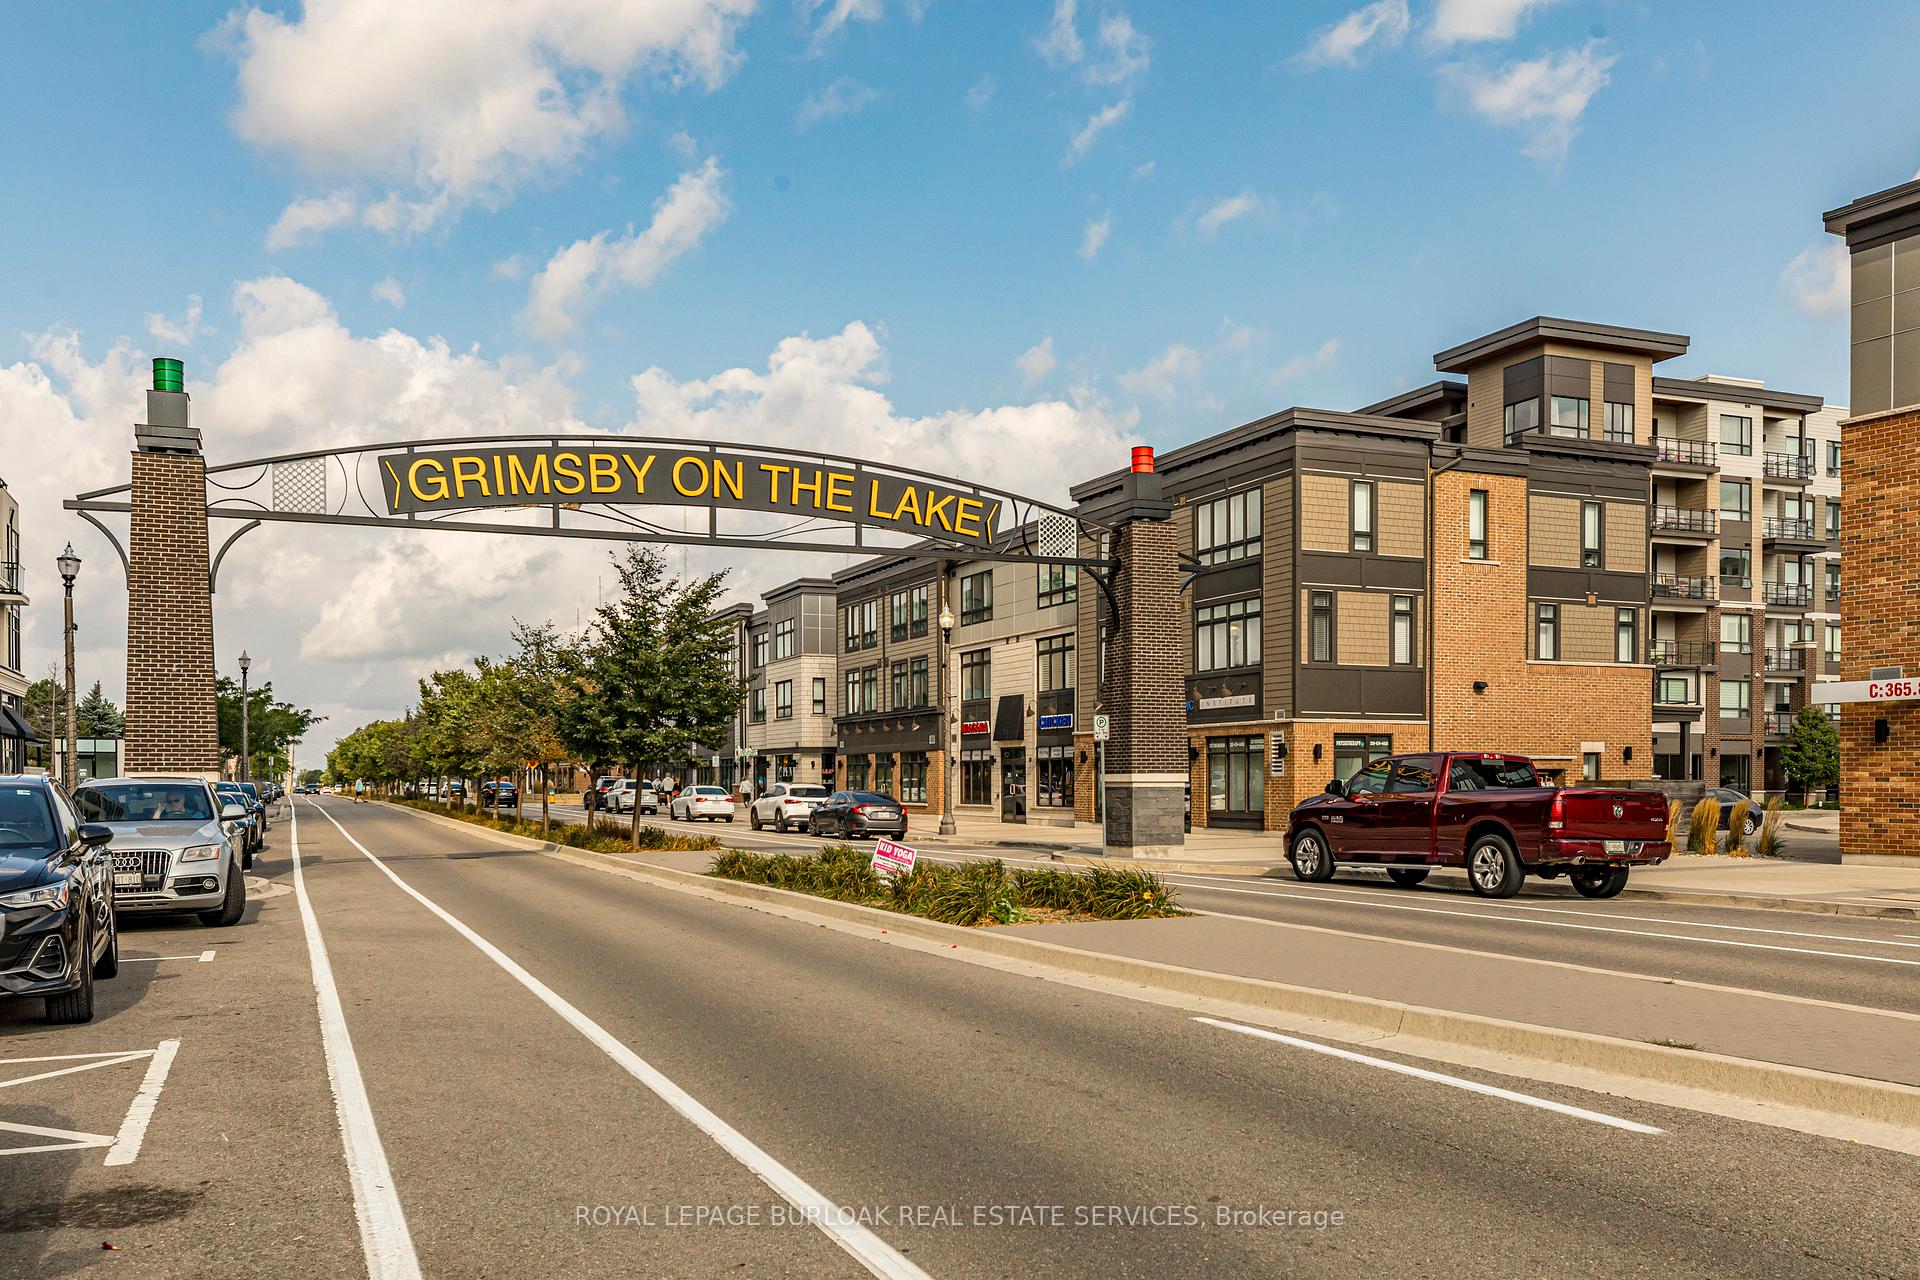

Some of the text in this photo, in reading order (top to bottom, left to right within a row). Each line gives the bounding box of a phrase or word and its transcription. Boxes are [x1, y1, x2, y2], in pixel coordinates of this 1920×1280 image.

[407, 452, 985, 538] GRIMSBY ON THE LAKE
[1869, 681, 1920, 698] C:365.
[1200, 696, 1253, 707] INSTITUTE
[961, 721, 990, 734] NIAGARA
[1038, 714, 1073, 730] CHICKEN
[879, 841, 913, 860] KID YOGA
